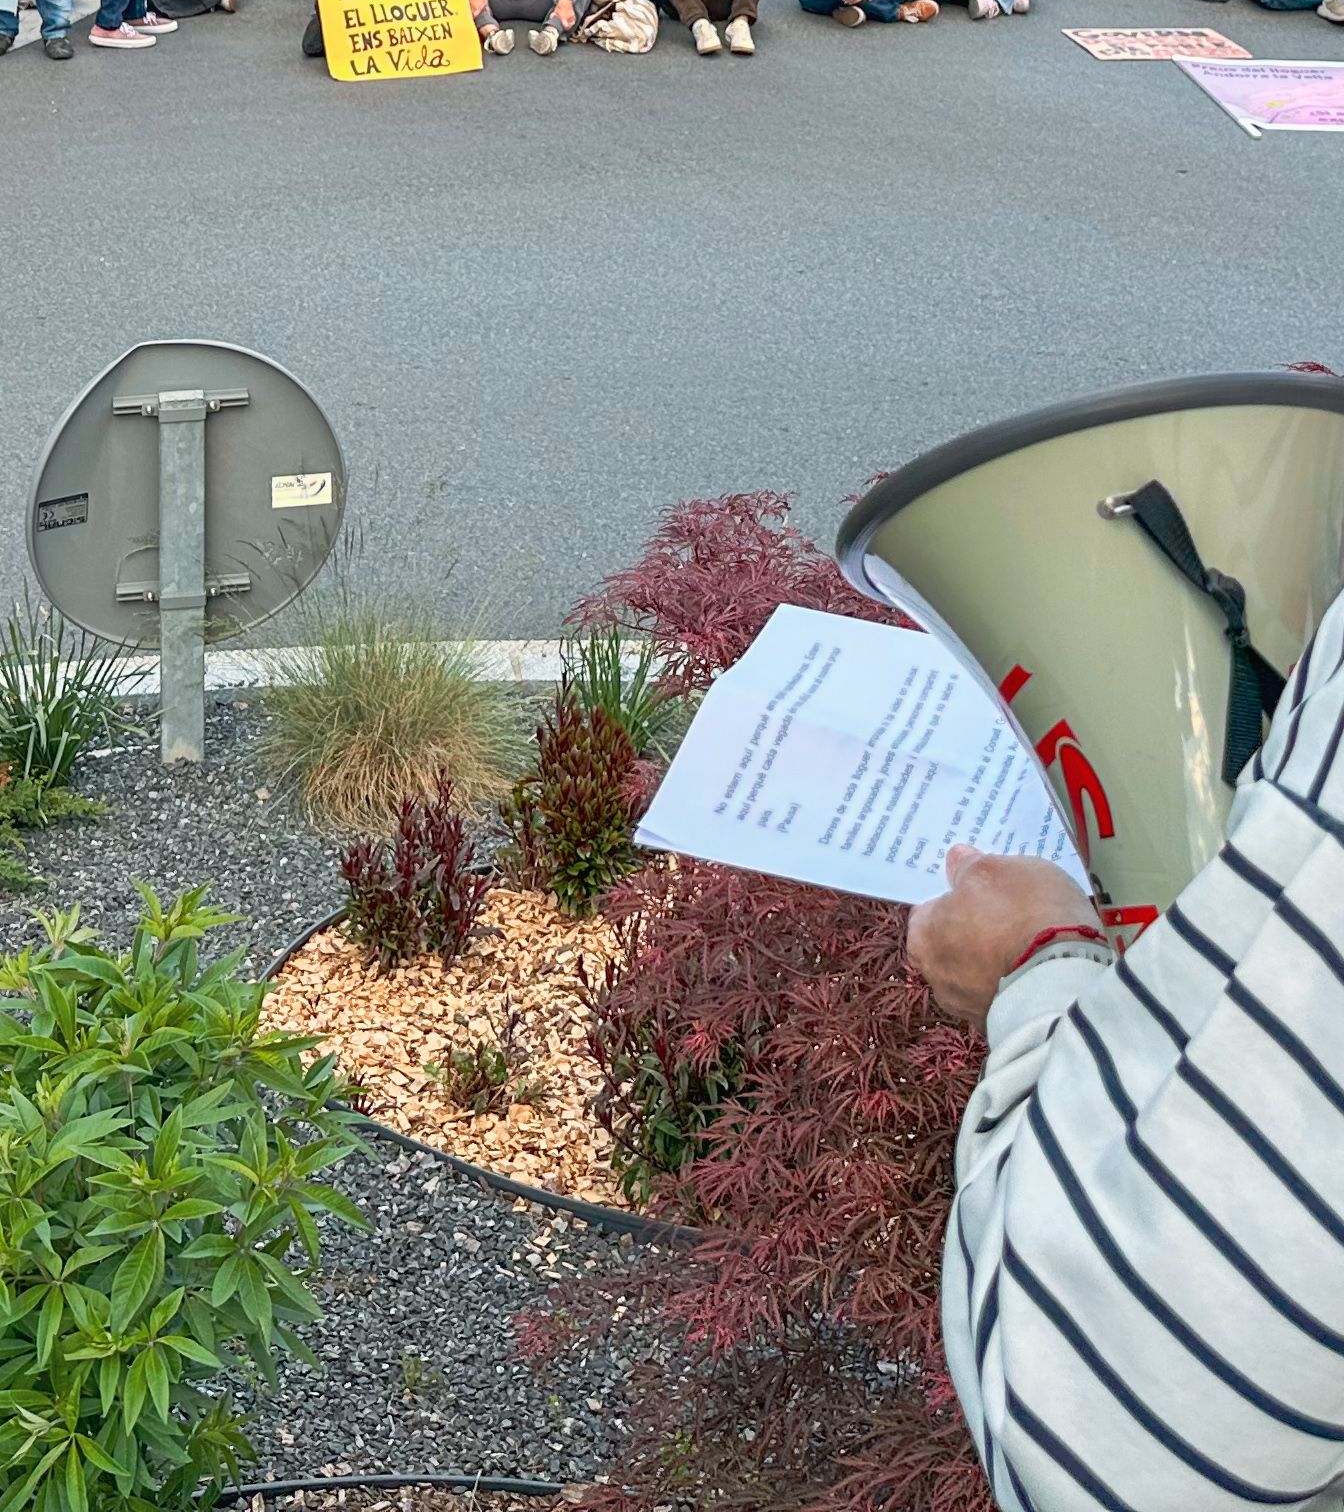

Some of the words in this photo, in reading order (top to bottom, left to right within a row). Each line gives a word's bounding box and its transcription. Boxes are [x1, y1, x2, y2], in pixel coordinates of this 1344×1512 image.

[343, 8, 366, 29] EL
[348, 30, 383, 53] ENS
[388, 22, 453, 47] BAIXEN
[350, 55, 381, 76] LA
[386, 45, 450, 72] Vida
[713, 799, 727, 815] No
